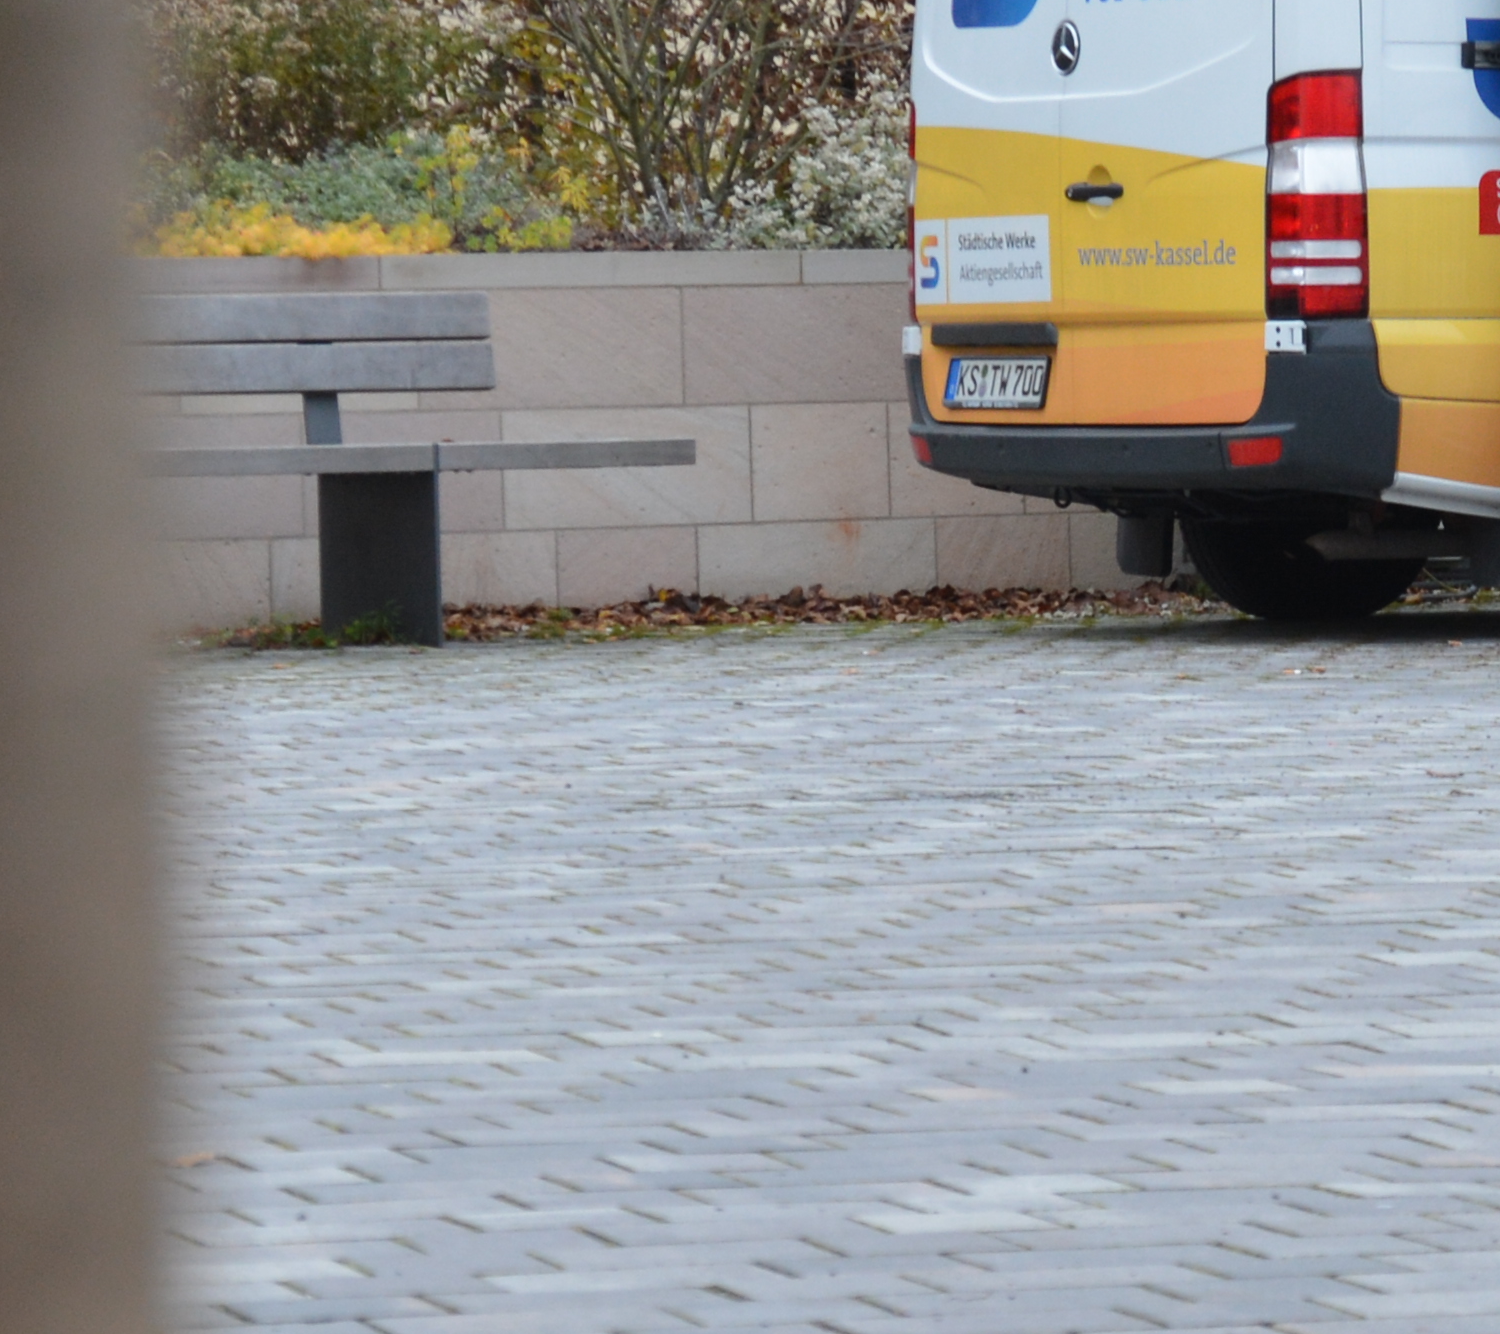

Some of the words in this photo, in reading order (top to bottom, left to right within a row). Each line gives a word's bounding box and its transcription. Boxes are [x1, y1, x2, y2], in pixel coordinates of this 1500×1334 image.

[958, 232, 1003, 251] Städtische
[1005, 230, 1036, 249] Werke
[1077, 238, 1237, 266] www.sw-kassel.de
[959, 261, 1044, 287] Aktiengesellschaft
[957, 364, 980, 396] KS
